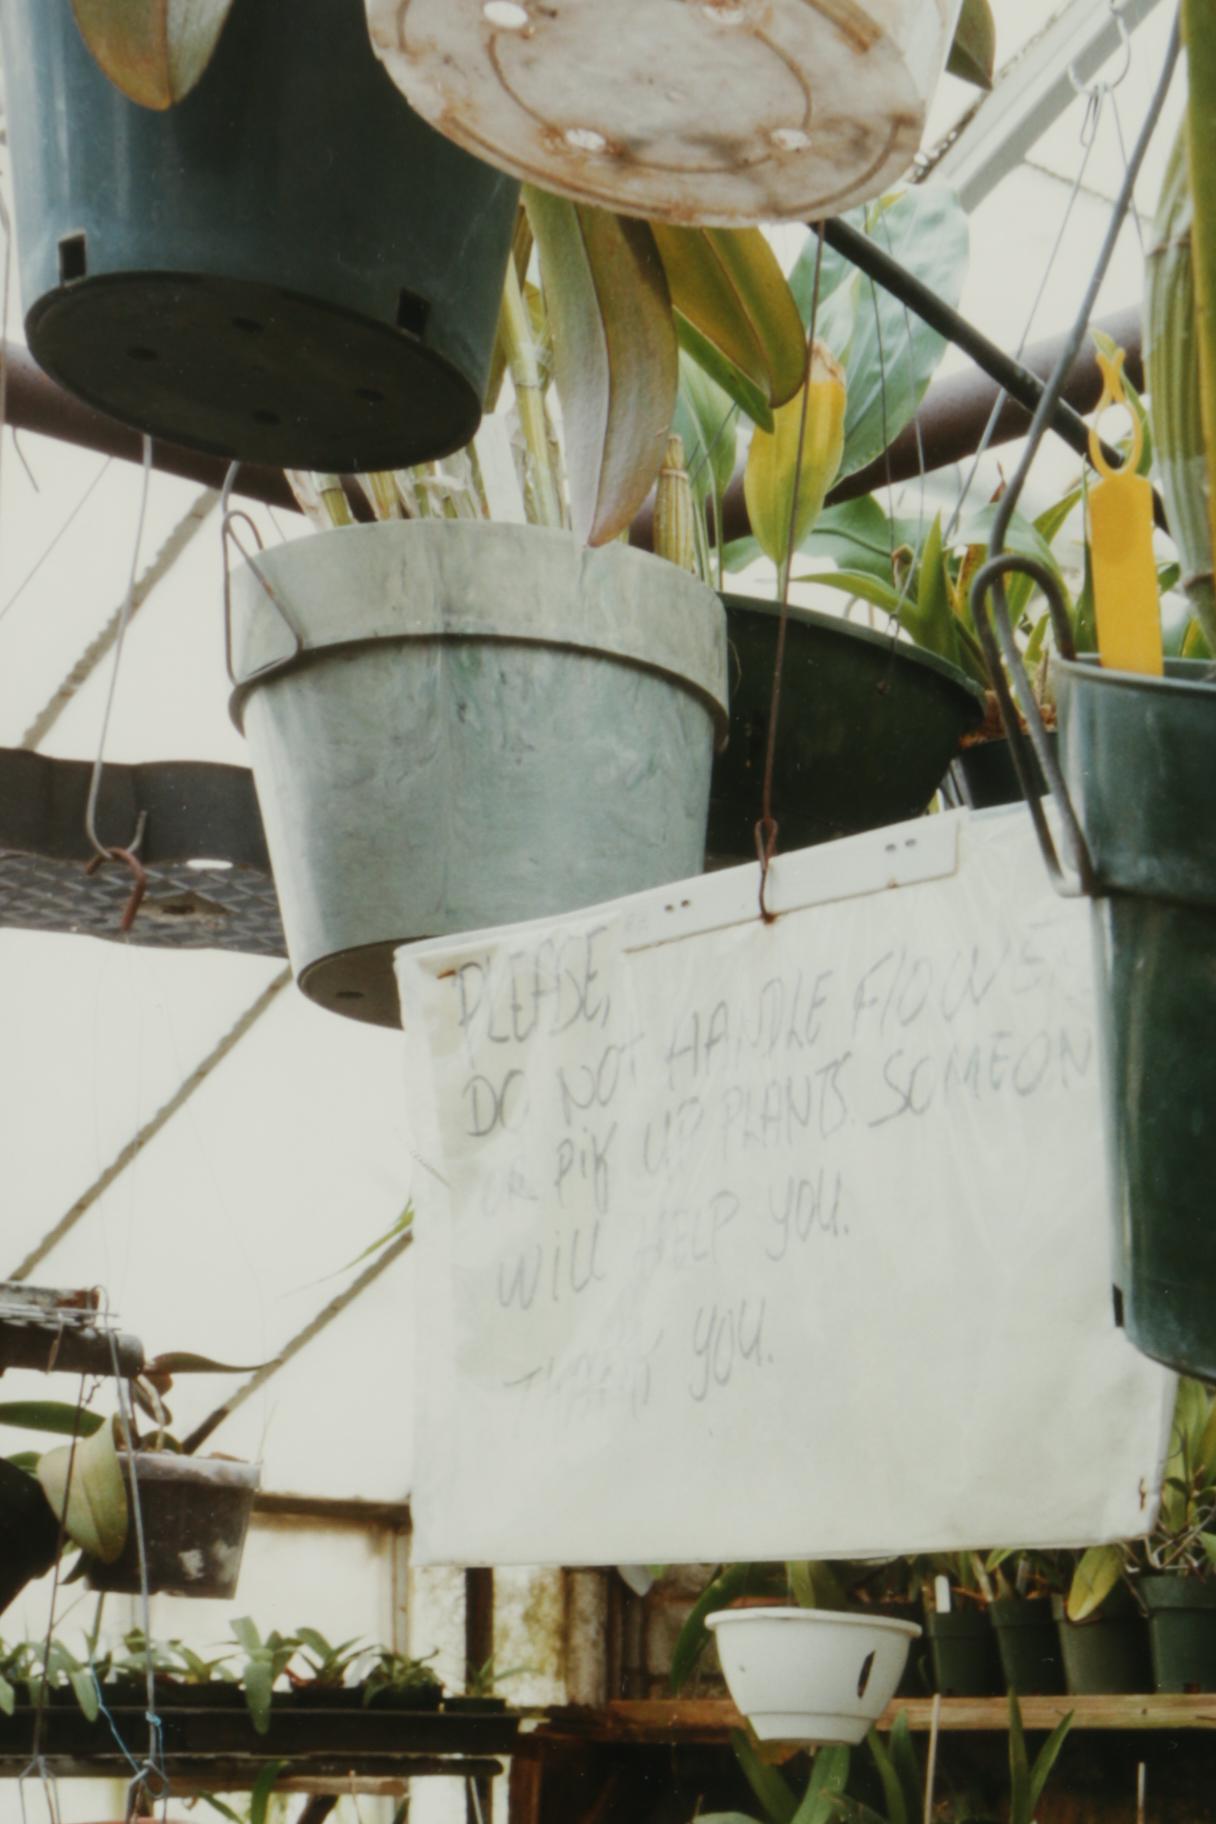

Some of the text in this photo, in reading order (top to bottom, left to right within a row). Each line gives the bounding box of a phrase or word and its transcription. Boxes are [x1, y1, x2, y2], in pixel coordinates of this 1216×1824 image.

[462, 1067, 532, 1139] DO
[557, 1032, 645, 1129] NOT
[664, 967, 835, 1094] HANDLE
[643, 1097, 706, 1182] UP
[866, 1018, 1093, 1130] SOMEON
[636, 1188, 743, 1284] HELP
